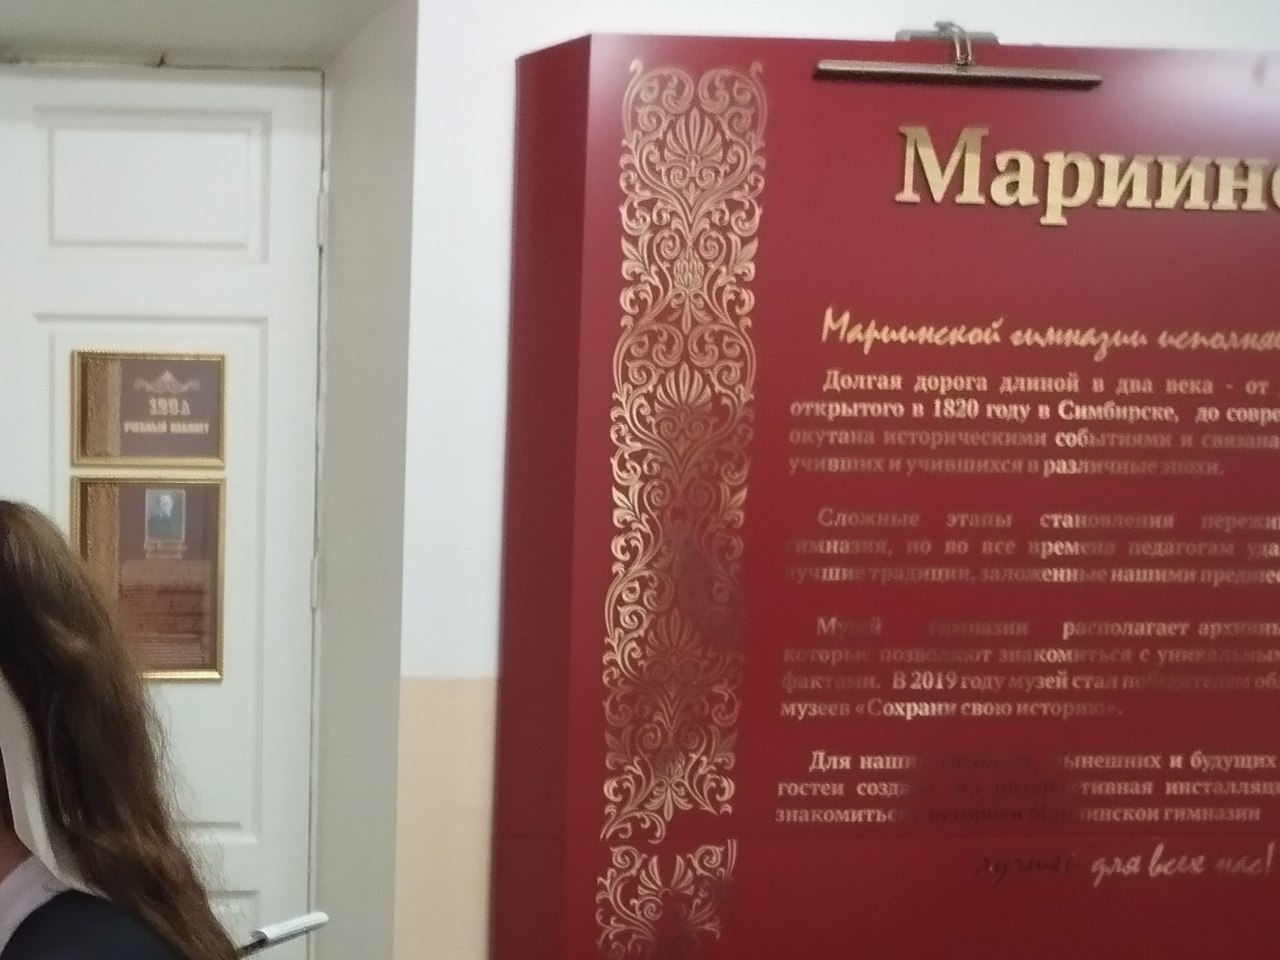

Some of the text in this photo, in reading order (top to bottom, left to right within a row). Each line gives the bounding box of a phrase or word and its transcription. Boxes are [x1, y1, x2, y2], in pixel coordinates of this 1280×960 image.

[822, 304, 1005, 356] Мариинской
[1010, 326, 1149, 362] гимназии
[822, 368, 902, 392] Долгая
[914, 374, 988, 395] дорога
[999, 372, 1080, 395] длиной
[1092, 378, 1104, 393] в
[1115, 378, 1153, 396] два
[1166, 379, 1213, 395] века
[1245, 380, 1269, 395] от
[790, 402, 904, 421] открытого
[912, 402, 925, 419] в
[933, 398, 979, 420] 1820
[986, 402, 1030, 424] году
[1038, 403, 1050, 420] в
[1058, 399, 1179, 424] Симбирске,
[1195, 406, 1220, 424] до
[788, 430, 875, 448] окутана
[883, 430, 1047, 450] историческими
[1055, 427, 1172, 448] событиями
[1180, 433, 1193, 448] и
[789, 456, 884, 476] учивших
[888, 458, 901, 472] и
[907, 458, 1022, 476] учившихся
[1026, 459, 1039, 474] в
[1043, 459, 1158, 478] различные
[818, 507, 920, 528] Сложные
[946, 512, 1013, 528] этапы
[1039, 513, 1174, 529] становления
[787, 539, 893, 557] имназия,
[906, 540, 932, 555] но
[944, 540, 969, 556] во
[980, 540, 1016, 556] все
[1028, 541, 1116, 559] времена
[1128, 541, 1235, 558] педагогам
[981, 567, 1108, 583] заложенные
[1110, 568, 1196, 583] нашими
[1062, 621, 1190, 641] располагает
[998, 648, 1132, 664] знакомиться
[1139, 648, 1150, 663] с
[892, 671, 906, 690] В
[910, 670, 958, 690] 2019
[960, 675, 1004, 693] году
[1008, 669, 1068, 693] музей
[1072, 675, 1118, 690] стал
[780, 702, 850, 721] музеев
[855, 698, 956, 721] «Сохрани
[960, 702, 1013, 718] свою
[808, 749, 852, 773] Для
[860, 754, 917, 770] наши
[1169, 754, 1183, 769] и
[1190, 750, 1277, 773] будущих
[775, 807, 900, 823] знакомитьс
[1163, 807, 1261, 822] гимназии
[1091, 855, 1142, 888] для
[1148, 842, 1205, 879] всех
